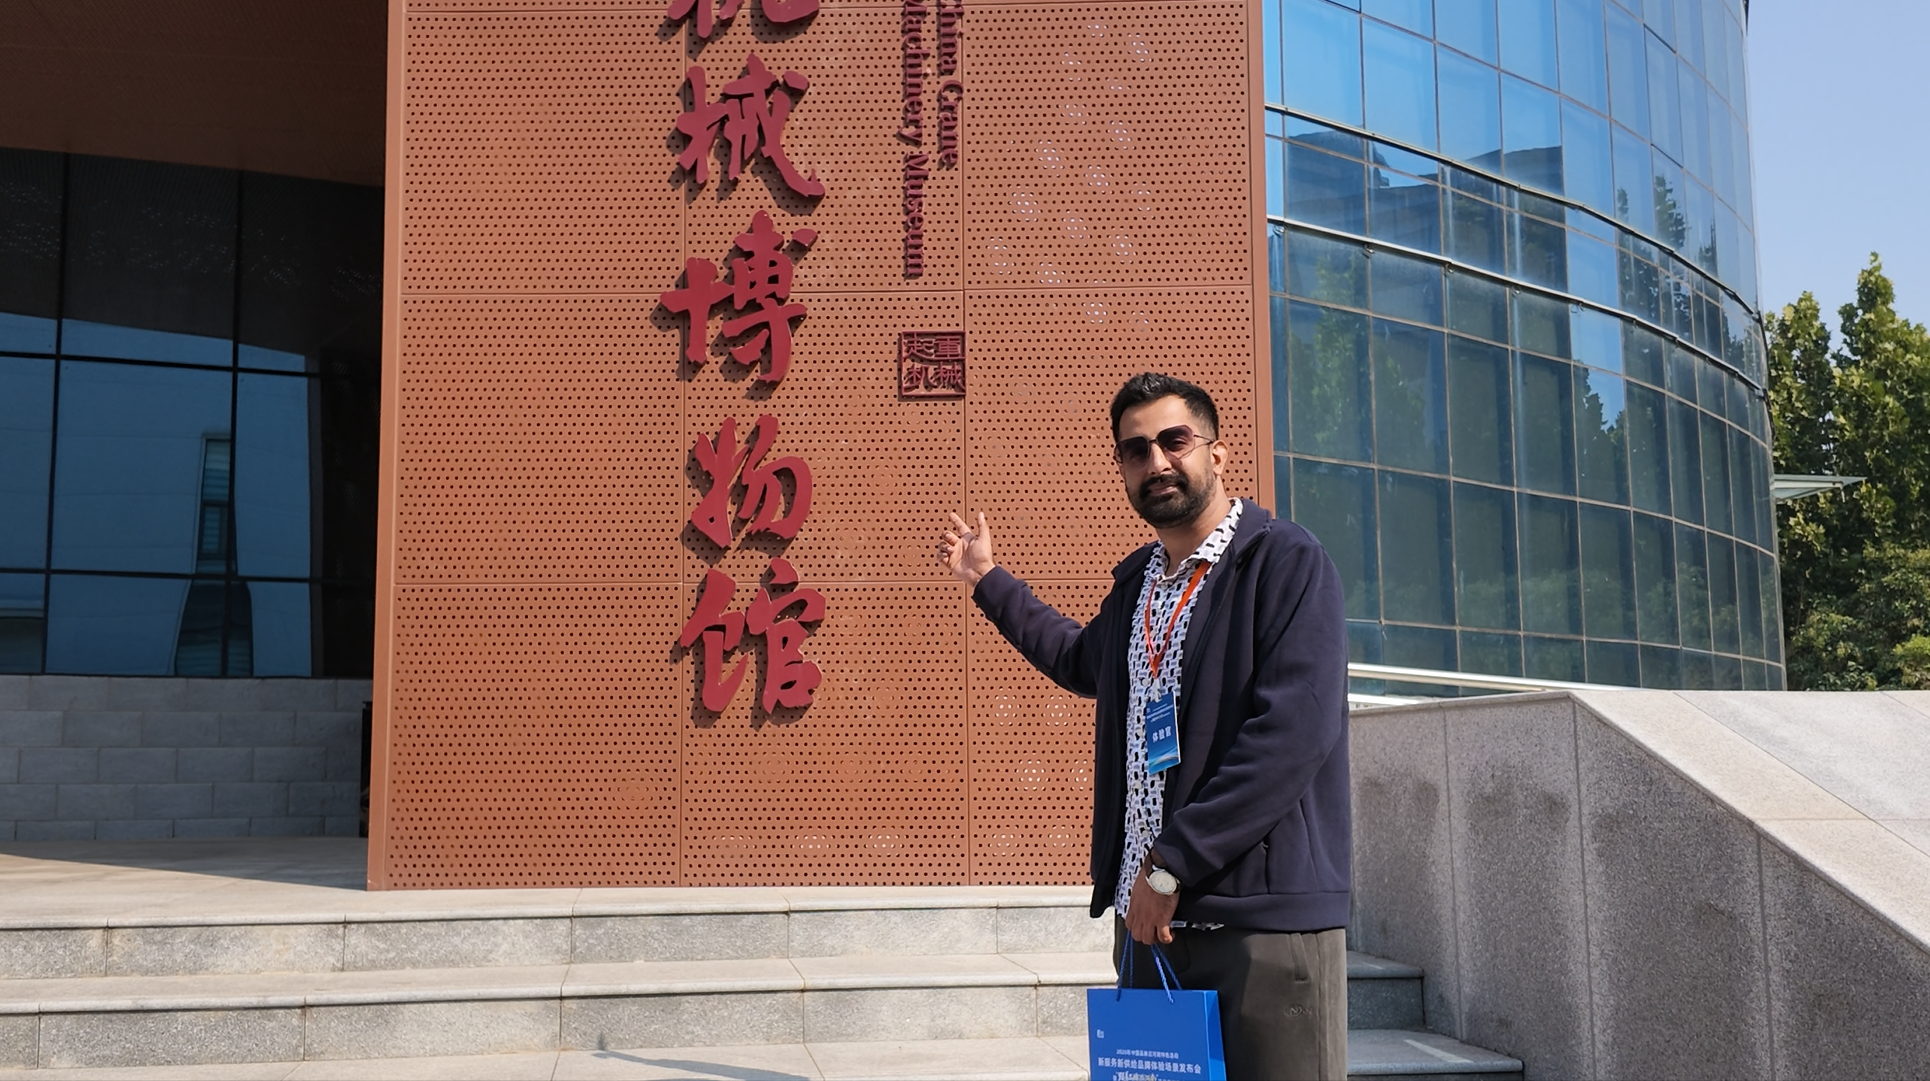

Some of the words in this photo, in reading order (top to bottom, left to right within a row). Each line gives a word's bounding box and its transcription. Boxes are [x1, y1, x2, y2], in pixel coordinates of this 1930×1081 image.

[939, 0, 964, 72] hina
[940, 79, 964, 164] Crane
[904, 152, 930, 275] Museum
